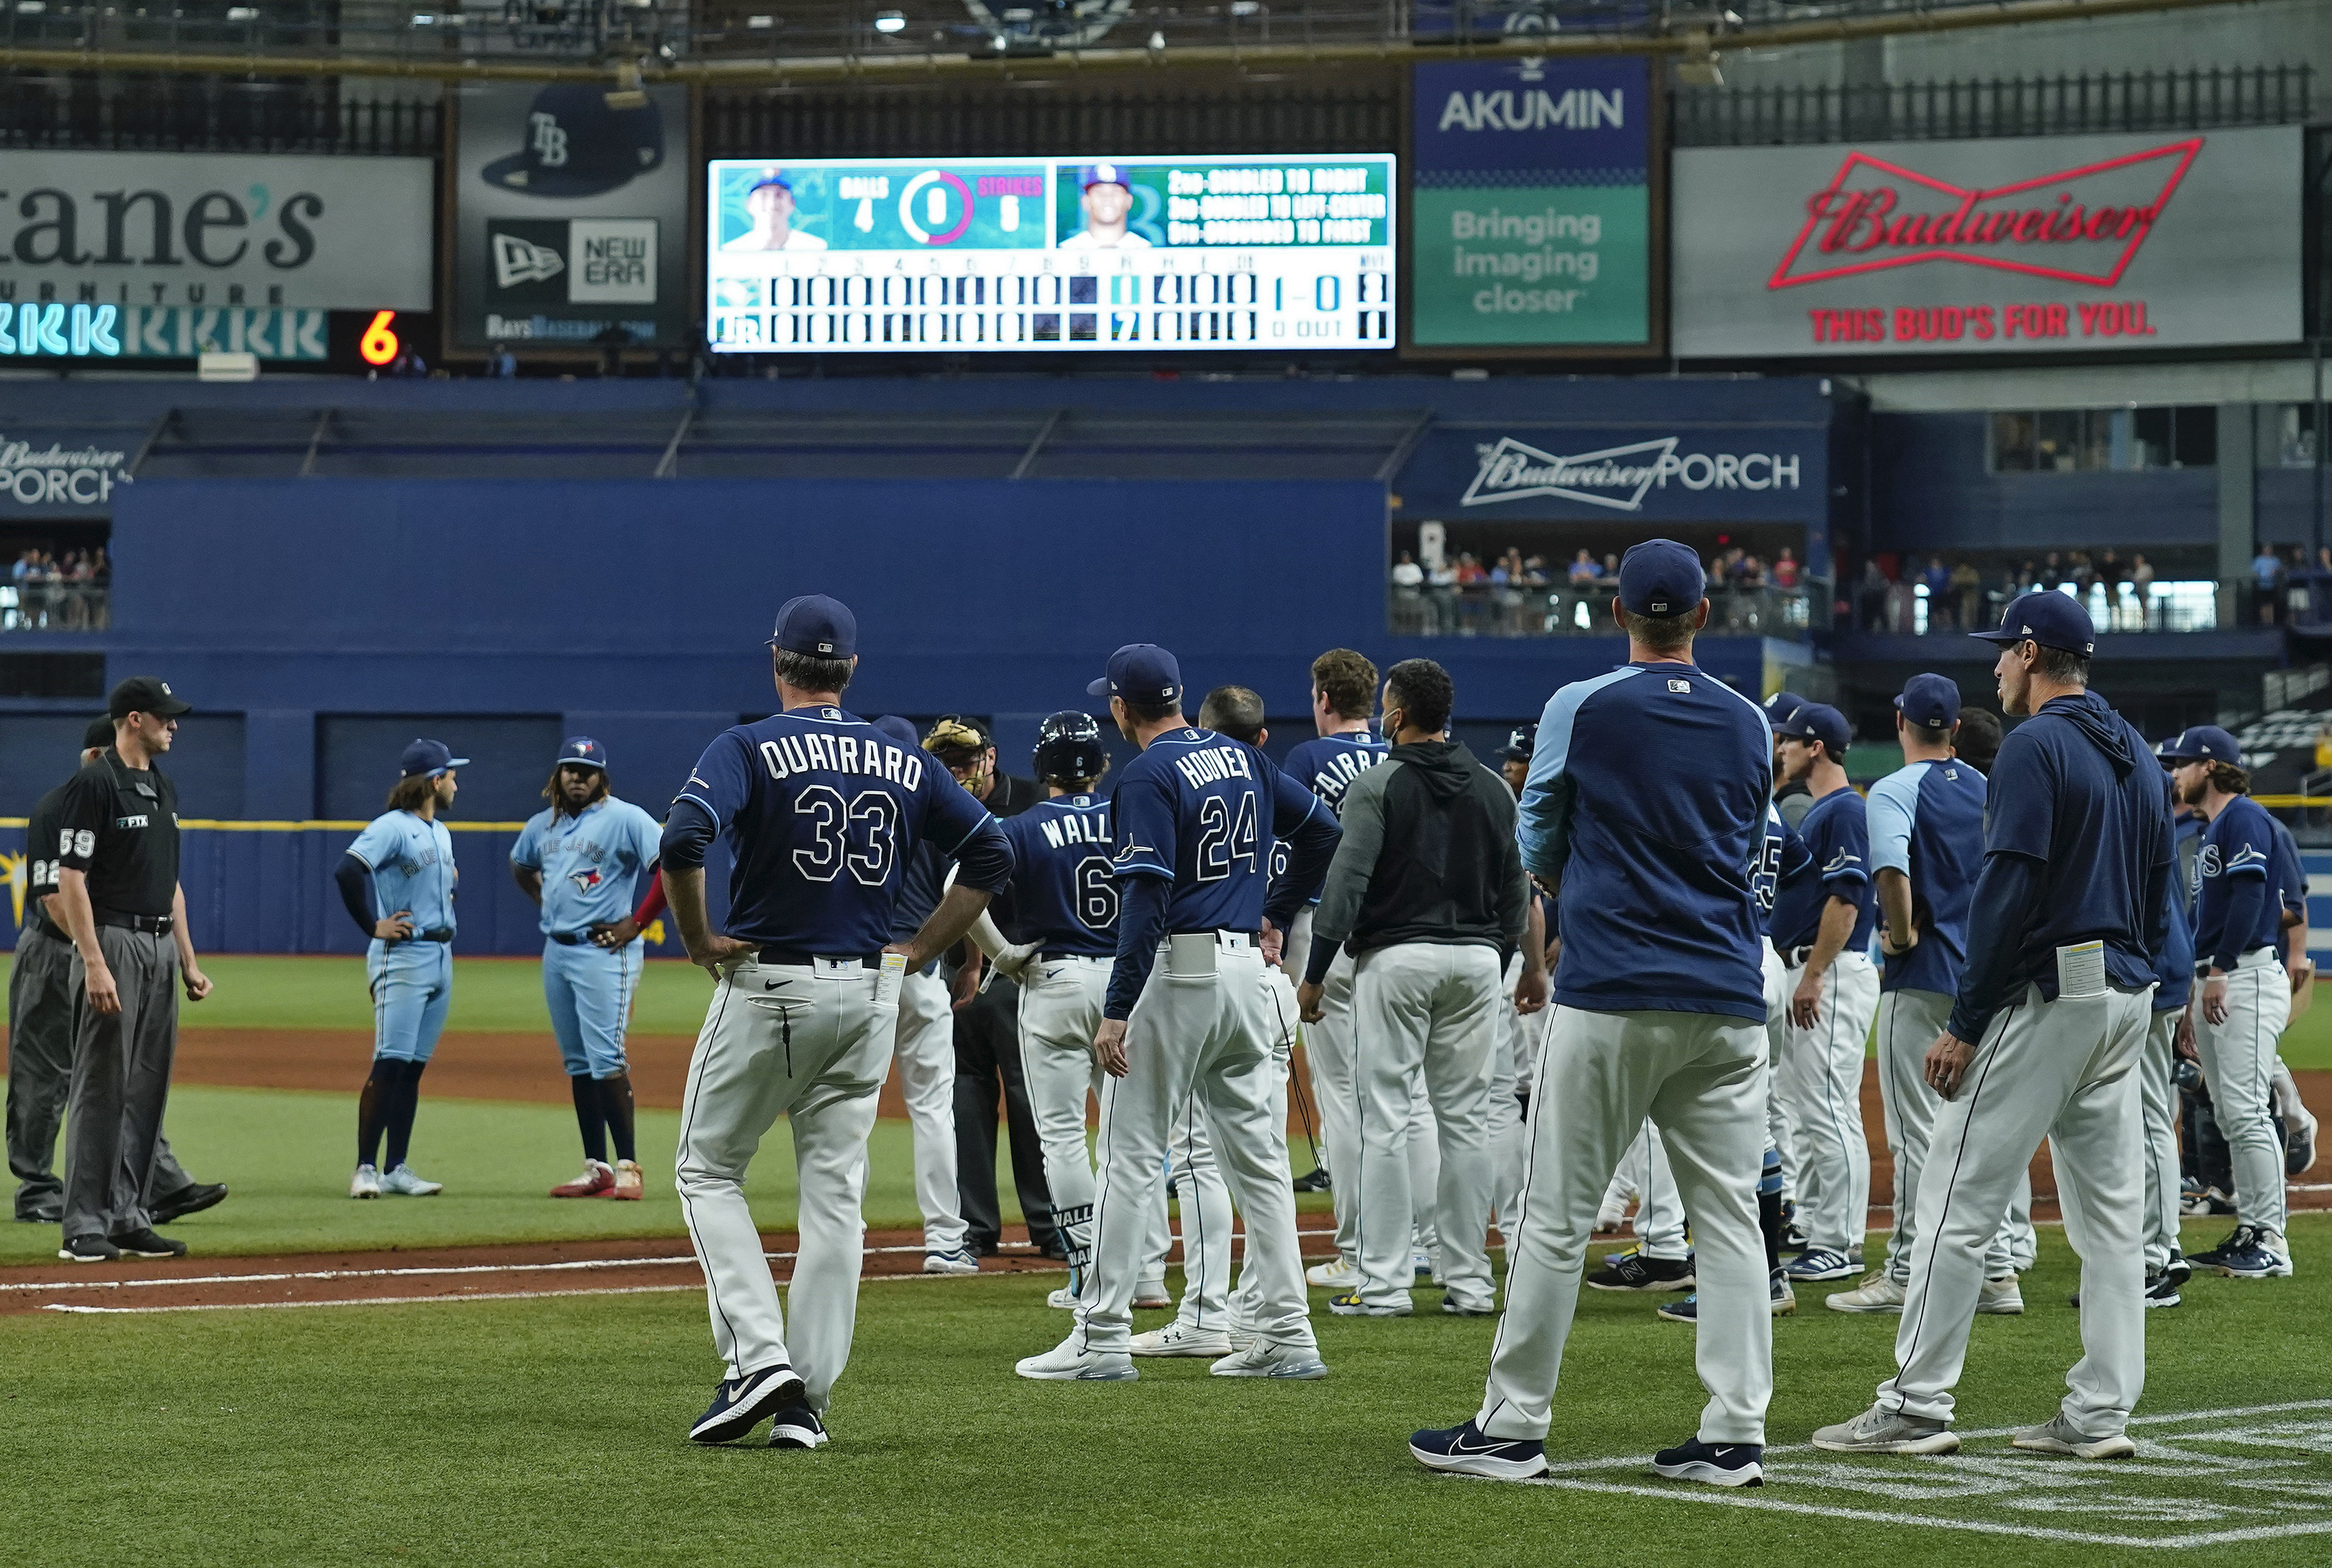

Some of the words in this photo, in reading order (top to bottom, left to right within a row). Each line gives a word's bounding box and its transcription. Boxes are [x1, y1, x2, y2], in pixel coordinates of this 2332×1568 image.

[1439, 87, 1624, 132] AKUMIN
[0, 183, 324, 269] ane's
[1452, 205, 1601, 245] Bringing
[1806, 188, 2156, 253] Budweiser
[585, 237, 646, 259] NEW
[1454, 243, 1599, 283] imaging
[586, 259, 646, 285] ERA
[1472, 282, 1580, 313] closer
[360, 311, 398, 366] 6
[1115, 311, 1136, 341] 7
[1297, 321, 1341, 337] OUT
[1809, 309, 1884, 342] THIS
[1894, 305, 1996, 341] BUD'S
[2004, 303, 2069, 338] FOR
[2077, 301, 2156, 336] YOU.
[1482, 454, 1662, 487] Budweiser
[1658, 453, 1801, 490] PORCH
[759, 733, 922, 792] QUATRARO
[1076, 756, 1083, 767] 6
[1176, 746, 1253, 790] HOOVER
[59, 828, 96, 859] 59
[793, 784, 898, 886] 33
[1197, 790, 1258, 882] 24
[1075, 856, 1118, 929] 6
[1052, 1206, 1093, 1228] WALL
